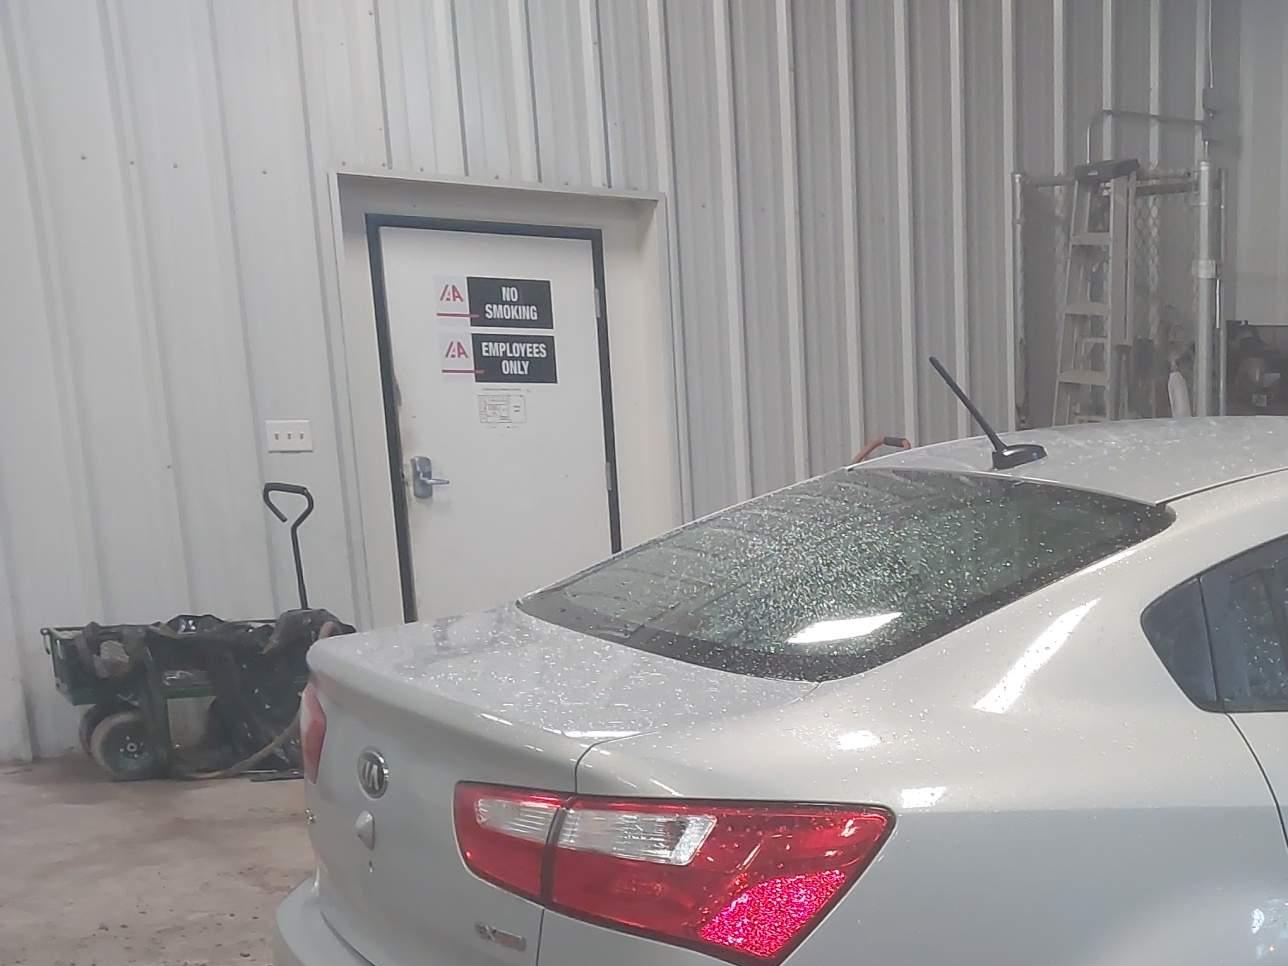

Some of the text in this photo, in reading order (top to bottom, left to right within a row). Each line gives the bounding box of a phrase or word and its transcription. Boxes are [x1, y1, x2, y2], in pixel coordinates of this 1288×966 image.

[501, 286, 518, 302] NO
[485, 304, 538, 321] SMOKING
[481, 341, 547, 358] EMPLOYEES
[501, 360, 530, 375] ONLY
